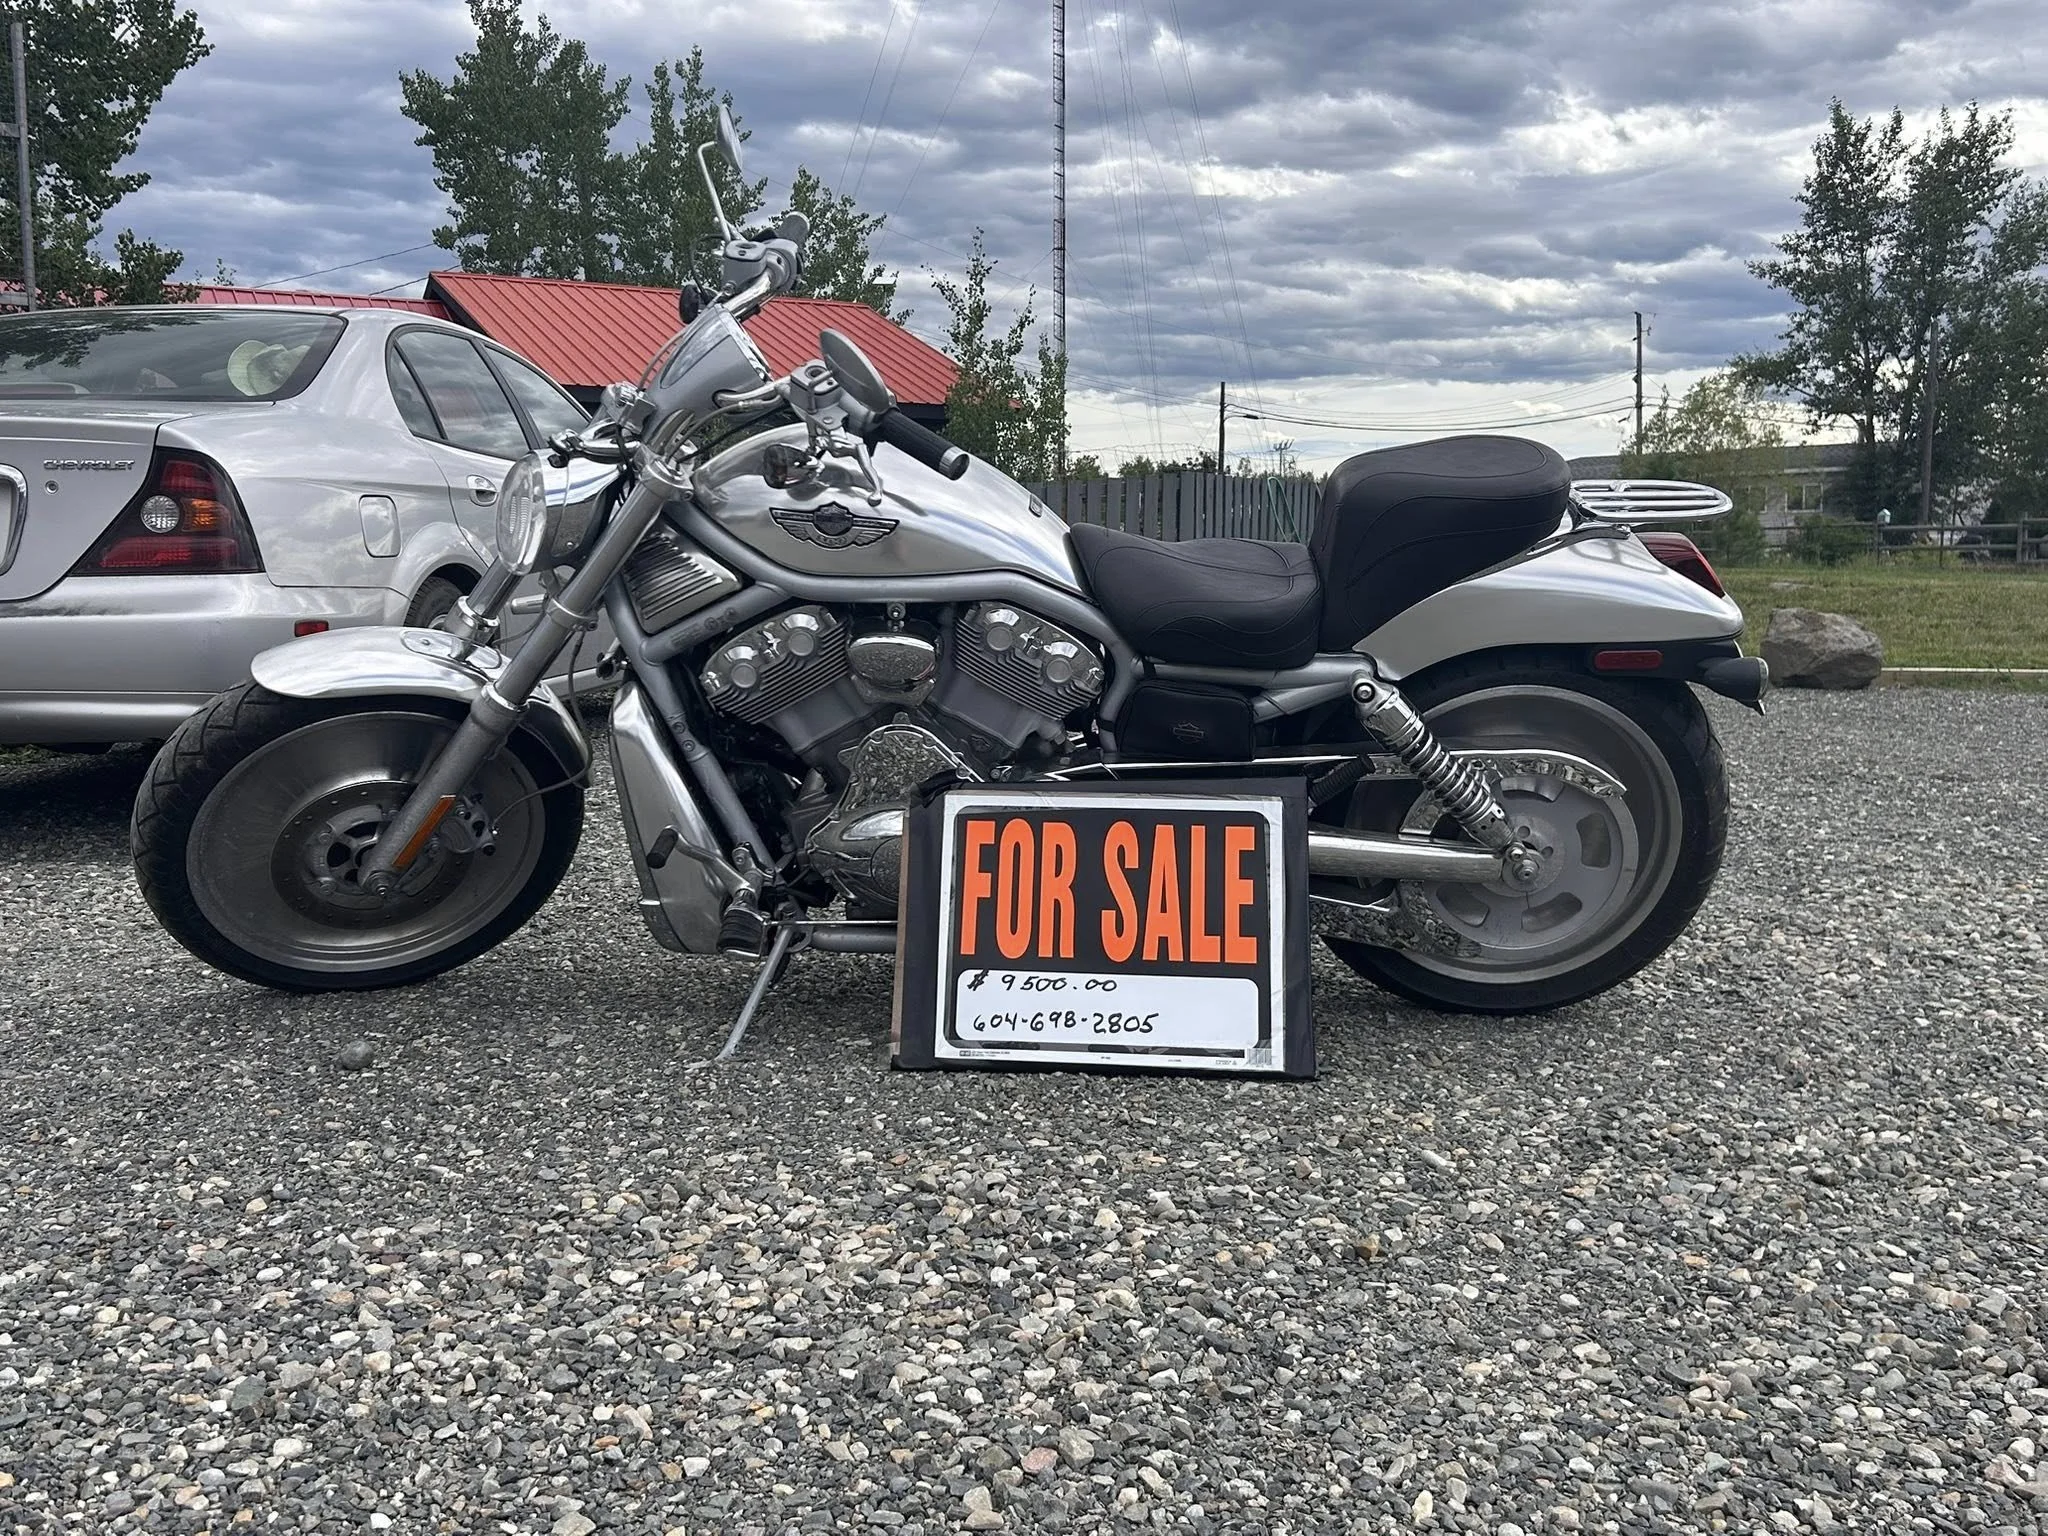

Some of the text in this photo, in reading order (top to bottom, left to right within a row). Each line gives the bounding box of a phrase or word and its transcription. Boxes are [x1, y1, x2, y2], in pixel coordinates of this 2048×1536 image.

[43, 459, 135, 471] CHEVROLET
[960, 818, 1258, 964] FOR SALE
[973, 1010, 1159, 1034] 604-698-2805
